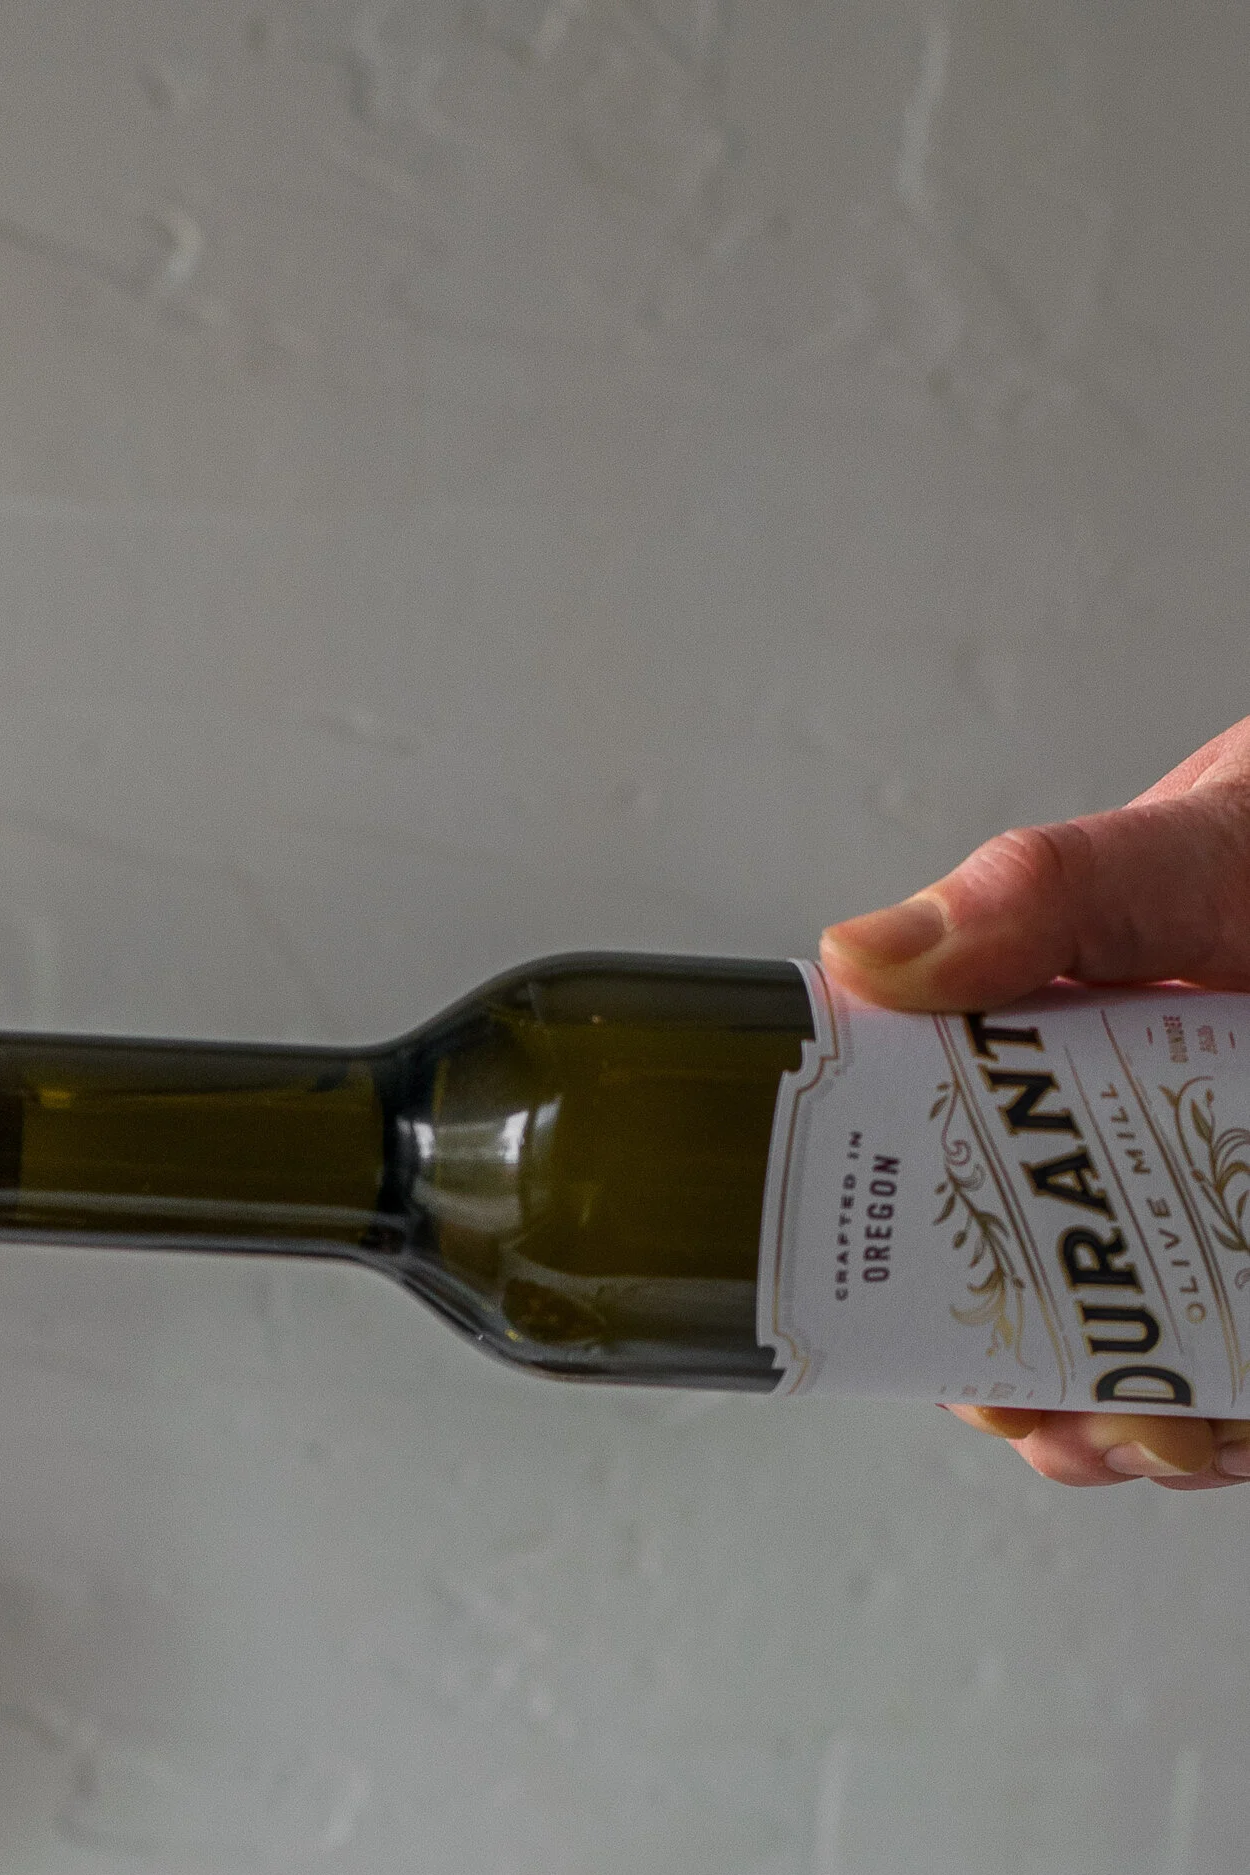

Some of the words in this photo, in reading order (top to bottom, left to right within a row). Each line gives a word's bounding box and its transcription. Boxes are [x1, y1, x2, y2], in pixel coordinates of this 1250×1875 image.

[1101, 1084, 1151, 1174] MILL
[835, 1173, 858, 1300] CRAFTED
[848, 1131, 862, 1160] IN
[862, 1155, 900, 1282] OREGON
[963, 1012, 1194, 1407] DURANT
[1147, 1198, 1206, 1323] OLIVE
